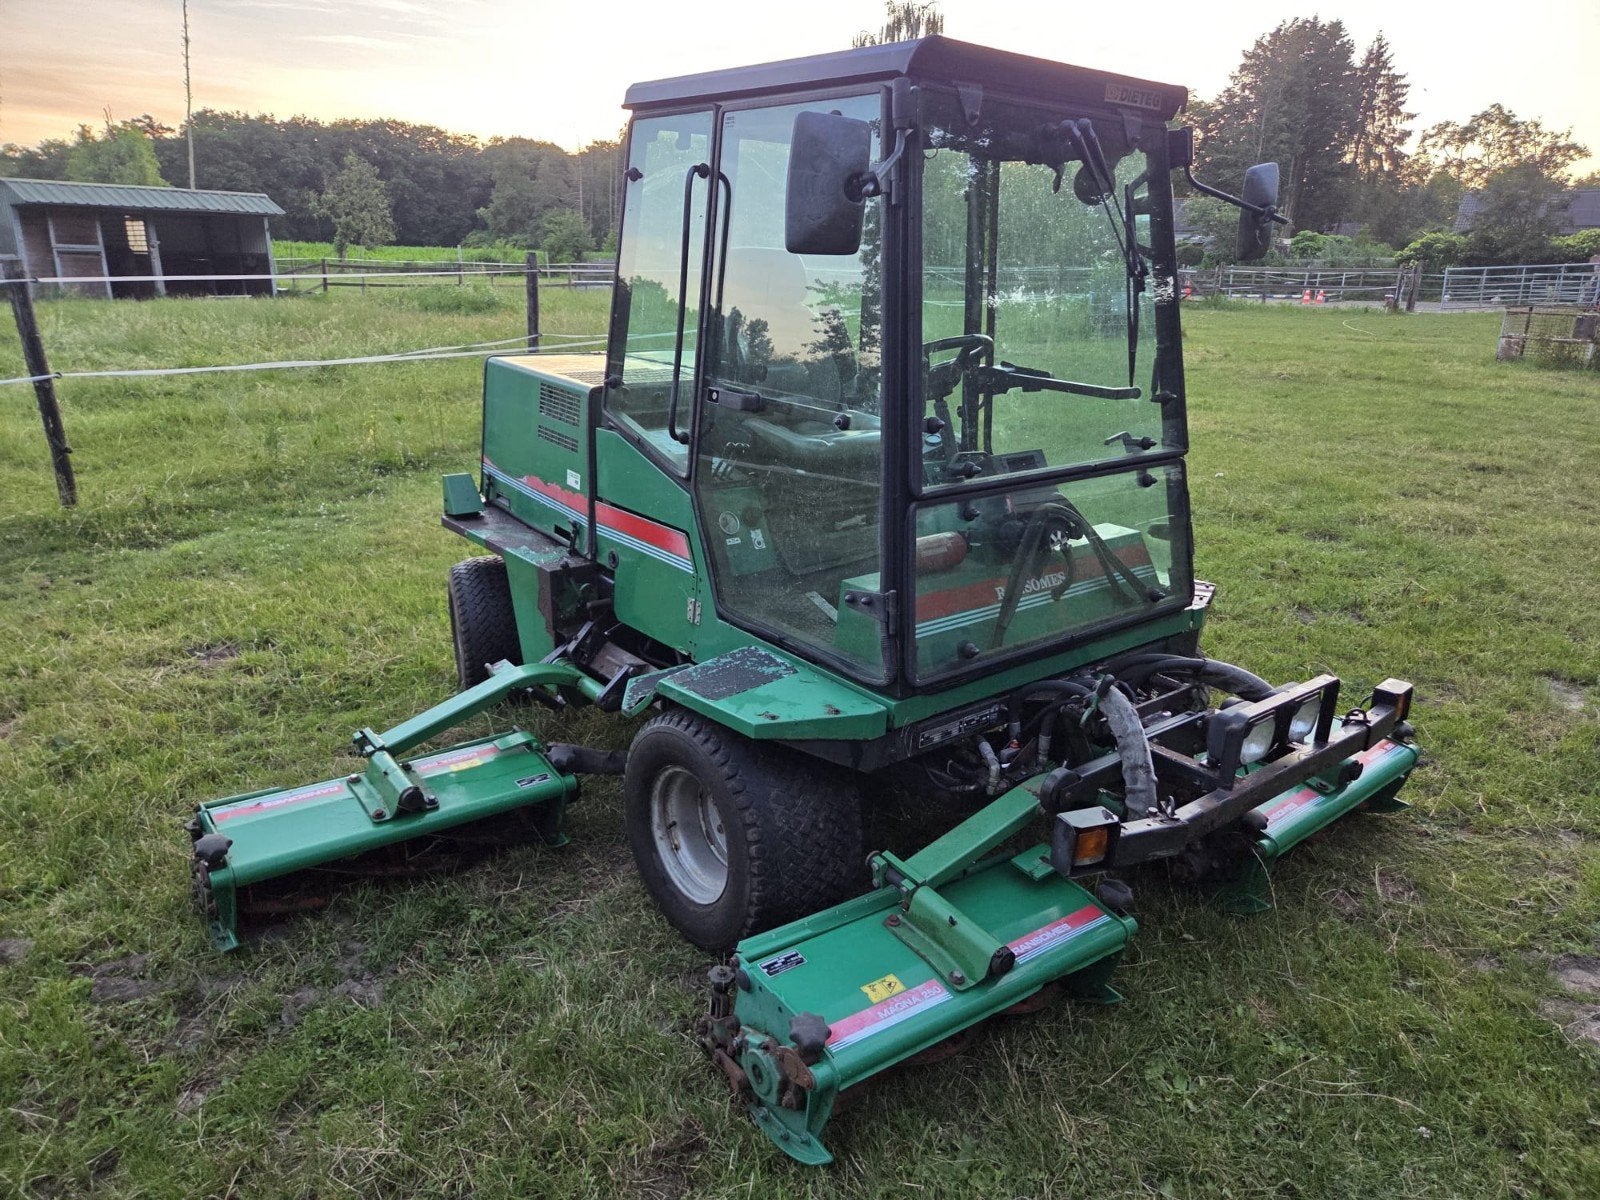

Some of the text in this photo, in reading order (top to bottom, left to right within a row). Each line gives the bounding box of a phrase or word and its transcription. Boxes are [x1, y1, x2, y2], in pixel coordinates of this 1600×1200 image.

[995, 571, 1066, 600] RSOMES
[1011, 923, 1072, 955] RANSOMES
[877, 985, 941, 1019] MAGNA 250
